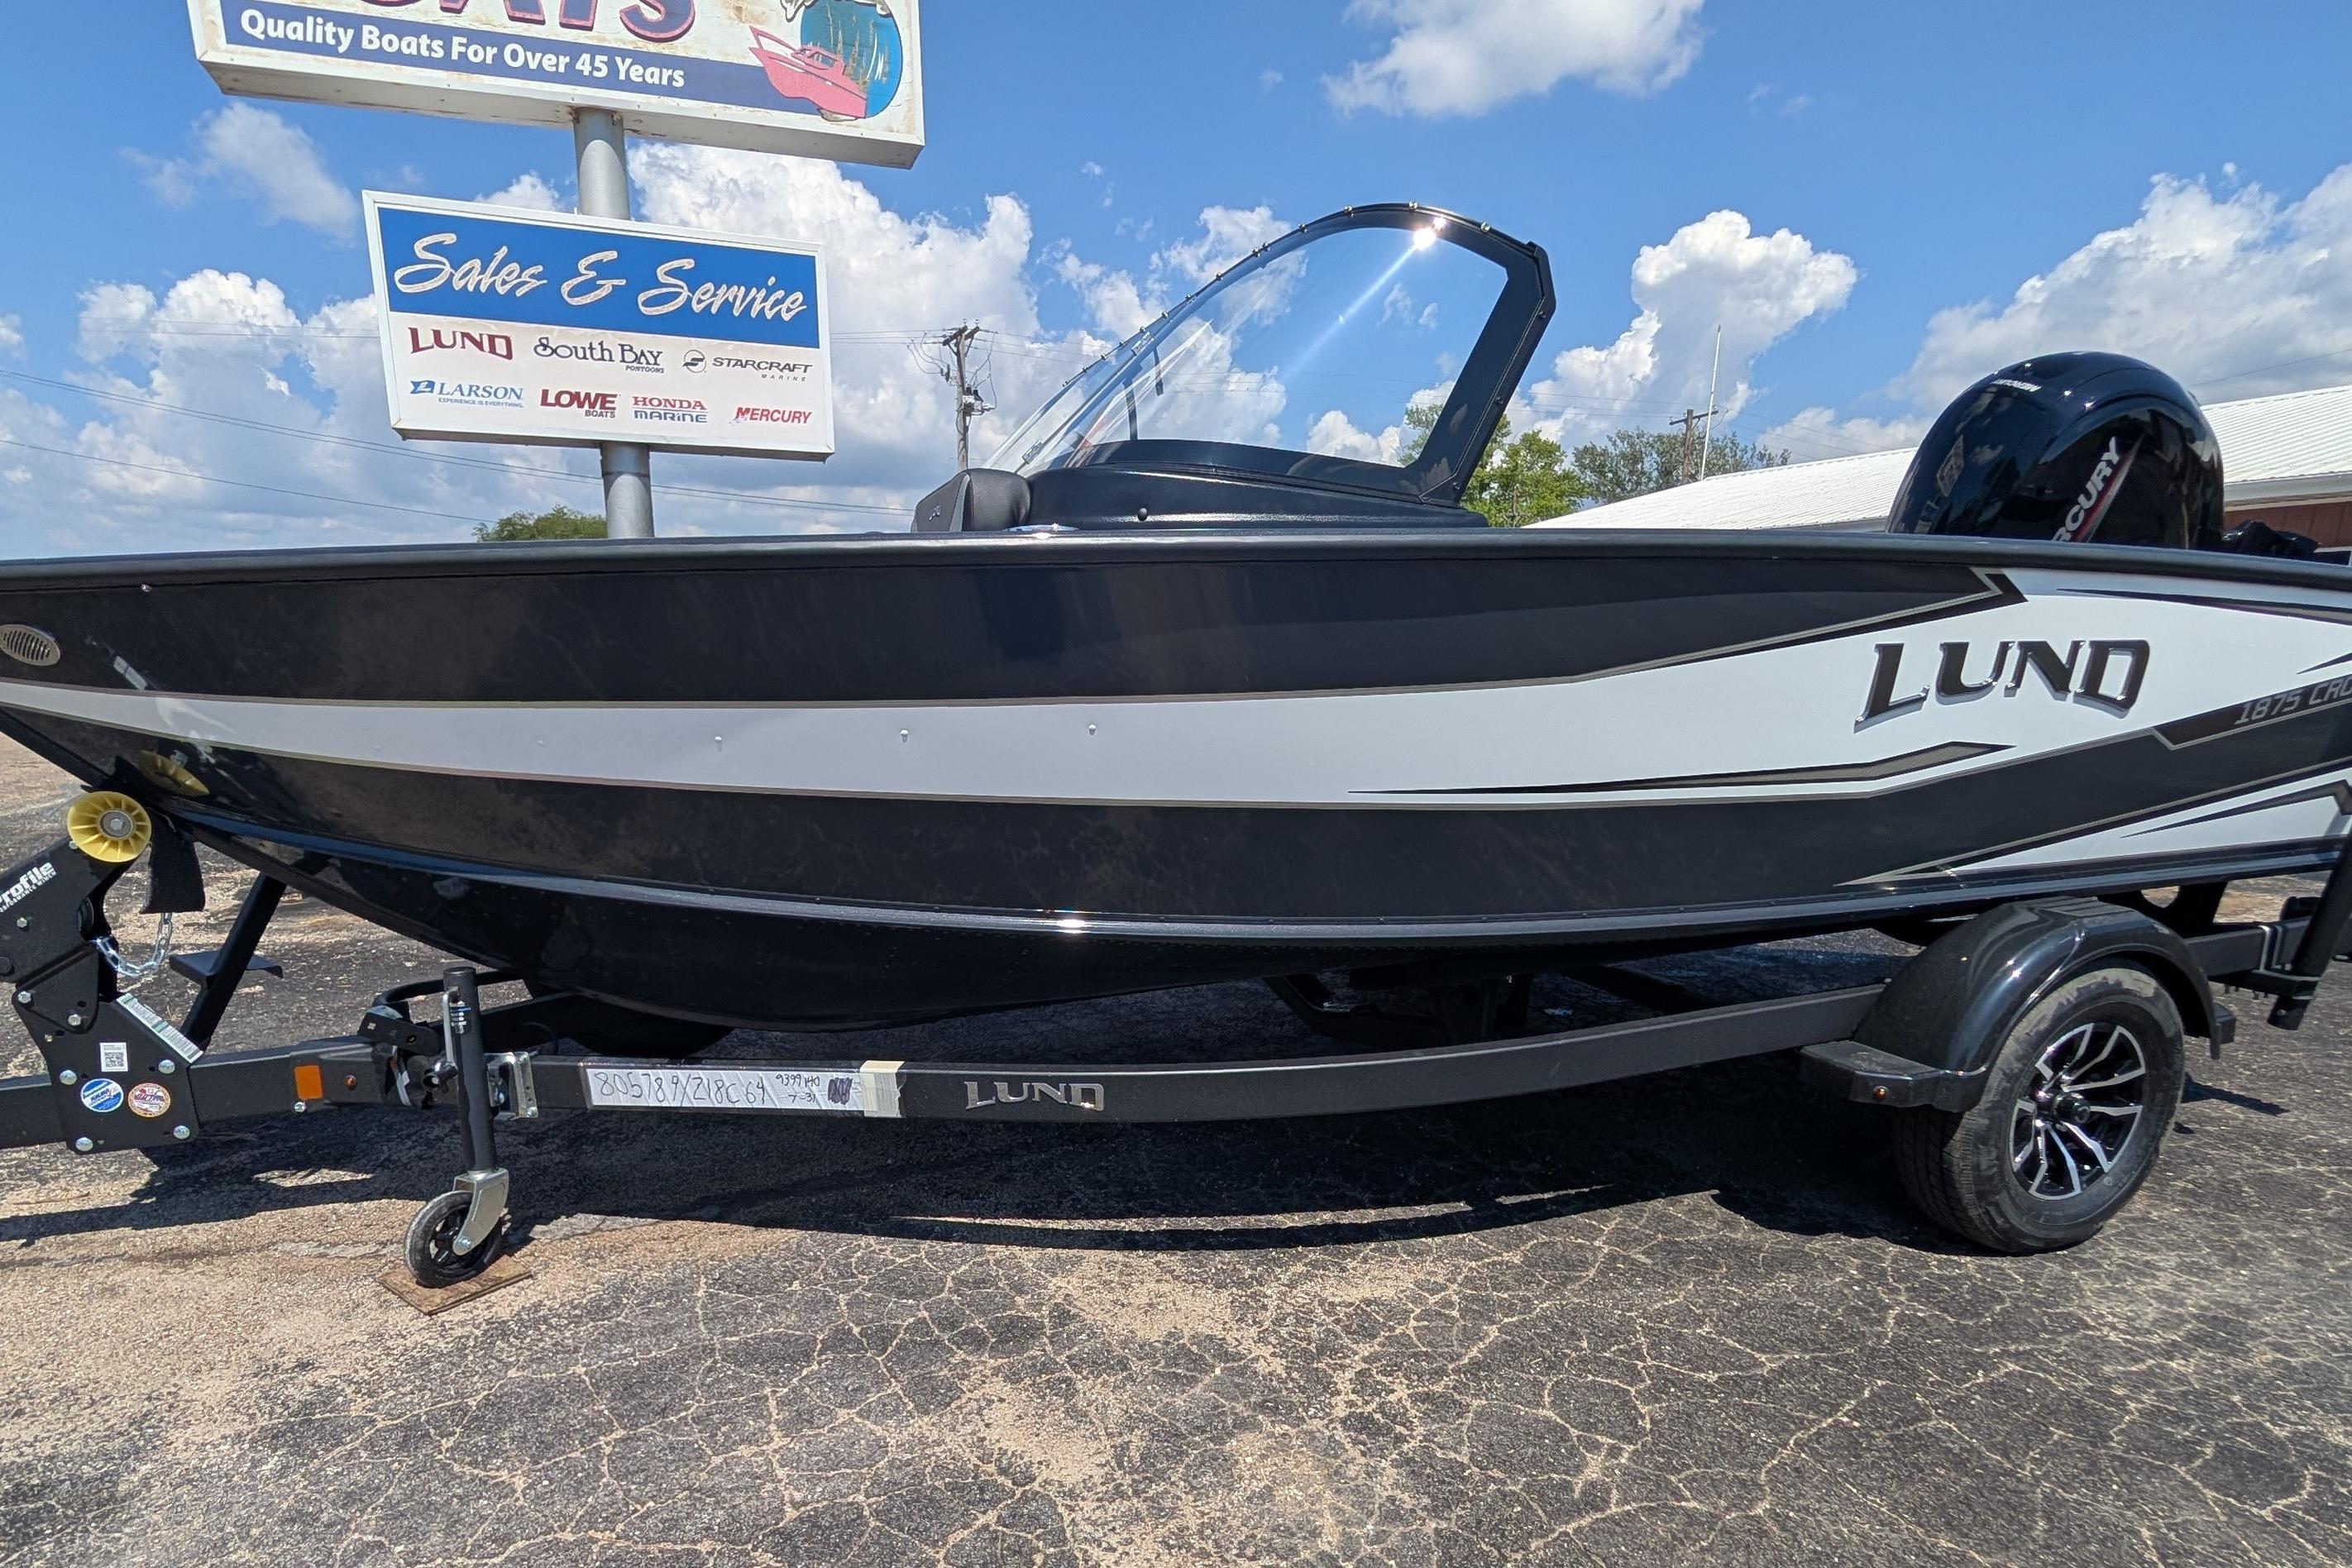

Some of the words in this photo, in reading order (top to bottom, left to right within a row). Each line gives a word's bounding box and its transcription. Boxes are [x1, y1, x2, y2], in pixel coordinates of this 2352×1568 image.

[241, 9, 355, 53] Quality
[361, 24, 445, 59] Boats
[451, 36, 497, 65] For
[503, 43, 570, 73] Over
[575, 53, 609, 78] 45
[614, 56, 685, 88] Years
[394, 233, 547, 297] Sales
[561, 250, 626, 305] &
[638, 258, 807, 321] Service
[408, 327, 514, 361] LUND
[533, 337, 614, 362] South
[618, 343, 663, 366] BAY
[625, 365, 664, 374] PONTOONS
[712, 356, 813, 374] STARCRAFT
[437, 382, 523, 399] LARSON
[761, 374, 806, 382] MARINE
[540, 389, 618, 410] LOWE
[633, 396, 707, 410] HONDA
[585, 409, 616, 418] BOATS
[734, 407, 812, 423] MERCURY
[1853, 639, 2150, 734] LUND
[2235, 689, 2304, 724] 1875
[0, 863, 55, 904] rofile
[964, 1081, 1104, 1111] LUND
